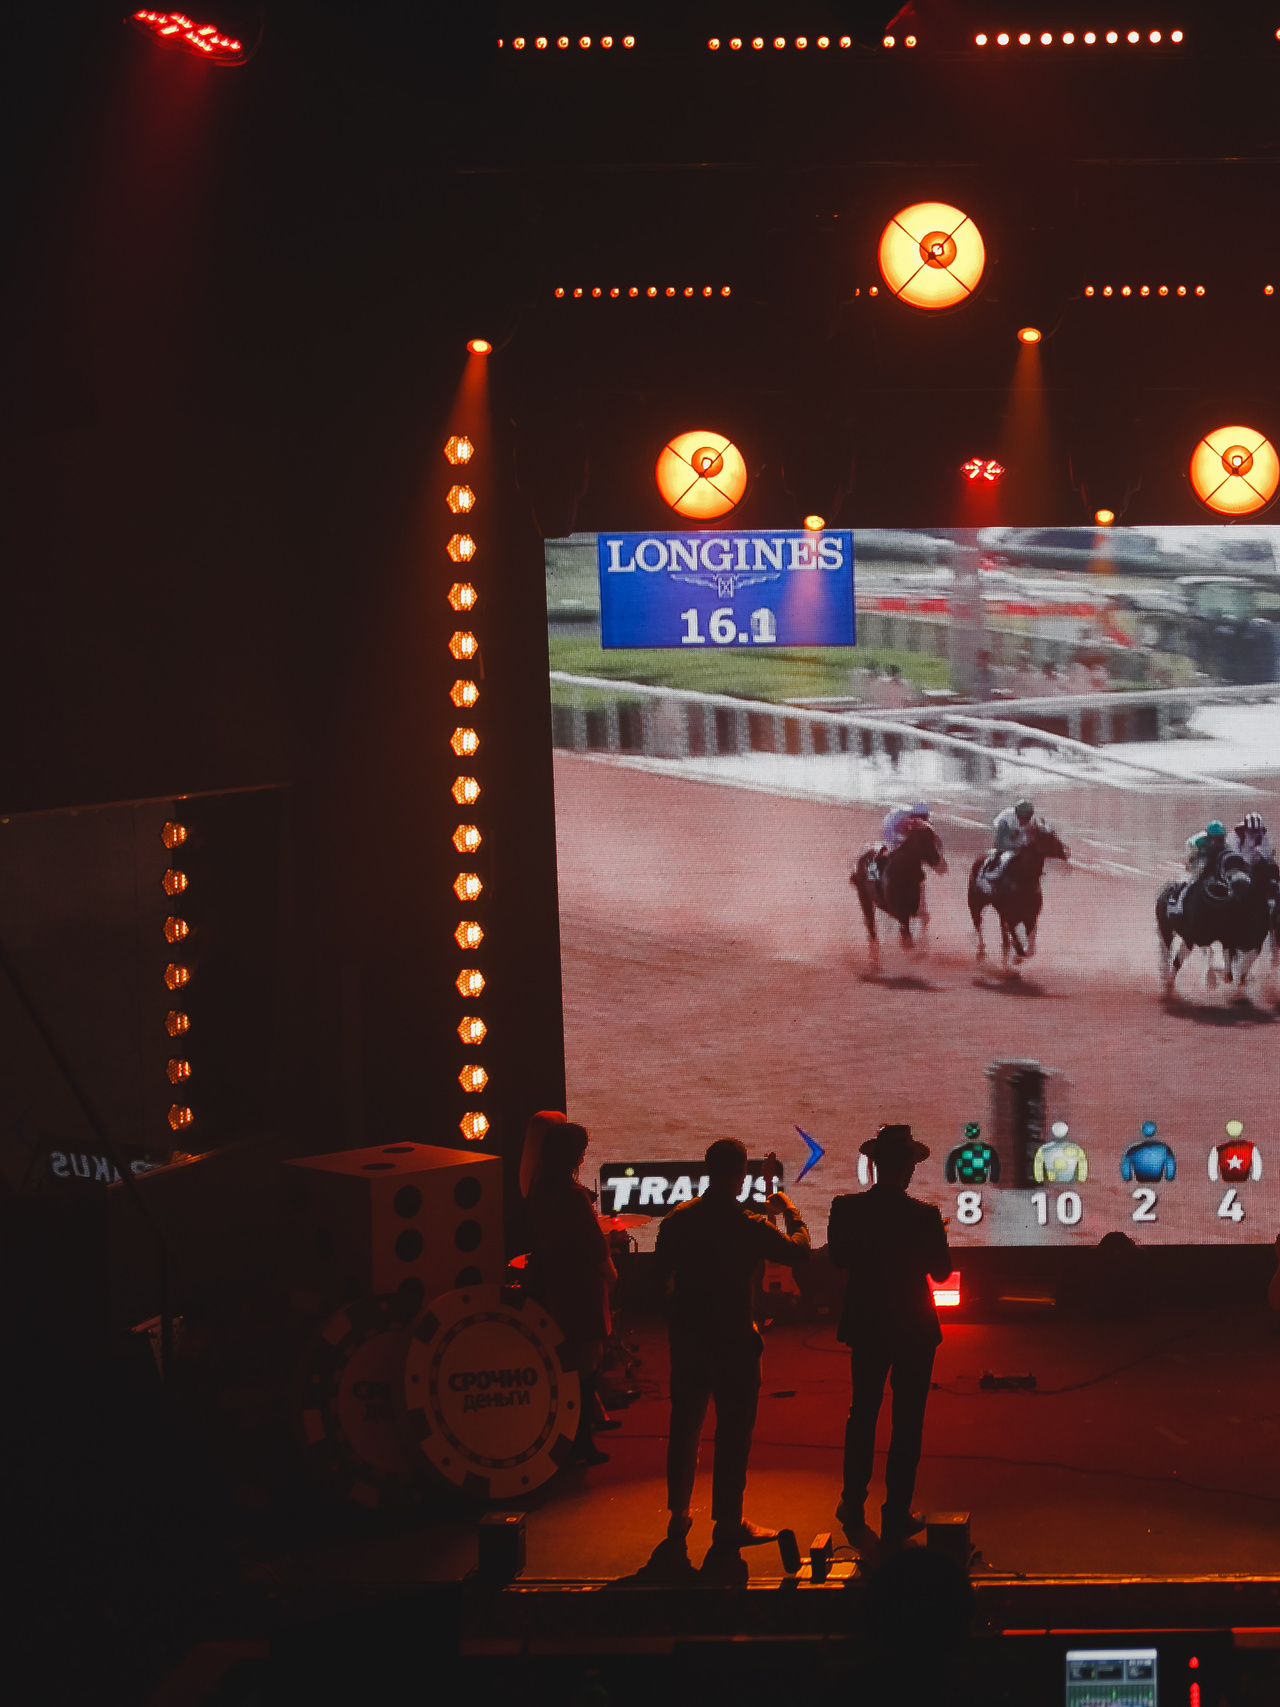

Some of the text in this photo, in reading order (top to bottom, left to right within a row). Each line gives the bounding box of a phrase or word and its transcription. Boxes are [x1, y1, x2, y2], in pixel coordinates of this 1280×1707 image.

[606, 536, 845, 573] LONGINES
[680, 606, 778, 645] 16.1
[607, 1174, 780, 1212] TRAS
[956, 1191, 983, 1225] 8
[1031, 1191, 1083, 1226] 10
[1131, 1187, 1158, 1222] 2
[1216, 1189, 1245, 1222] 4
[448, 1366, 538, 1393] СРОЧНО
